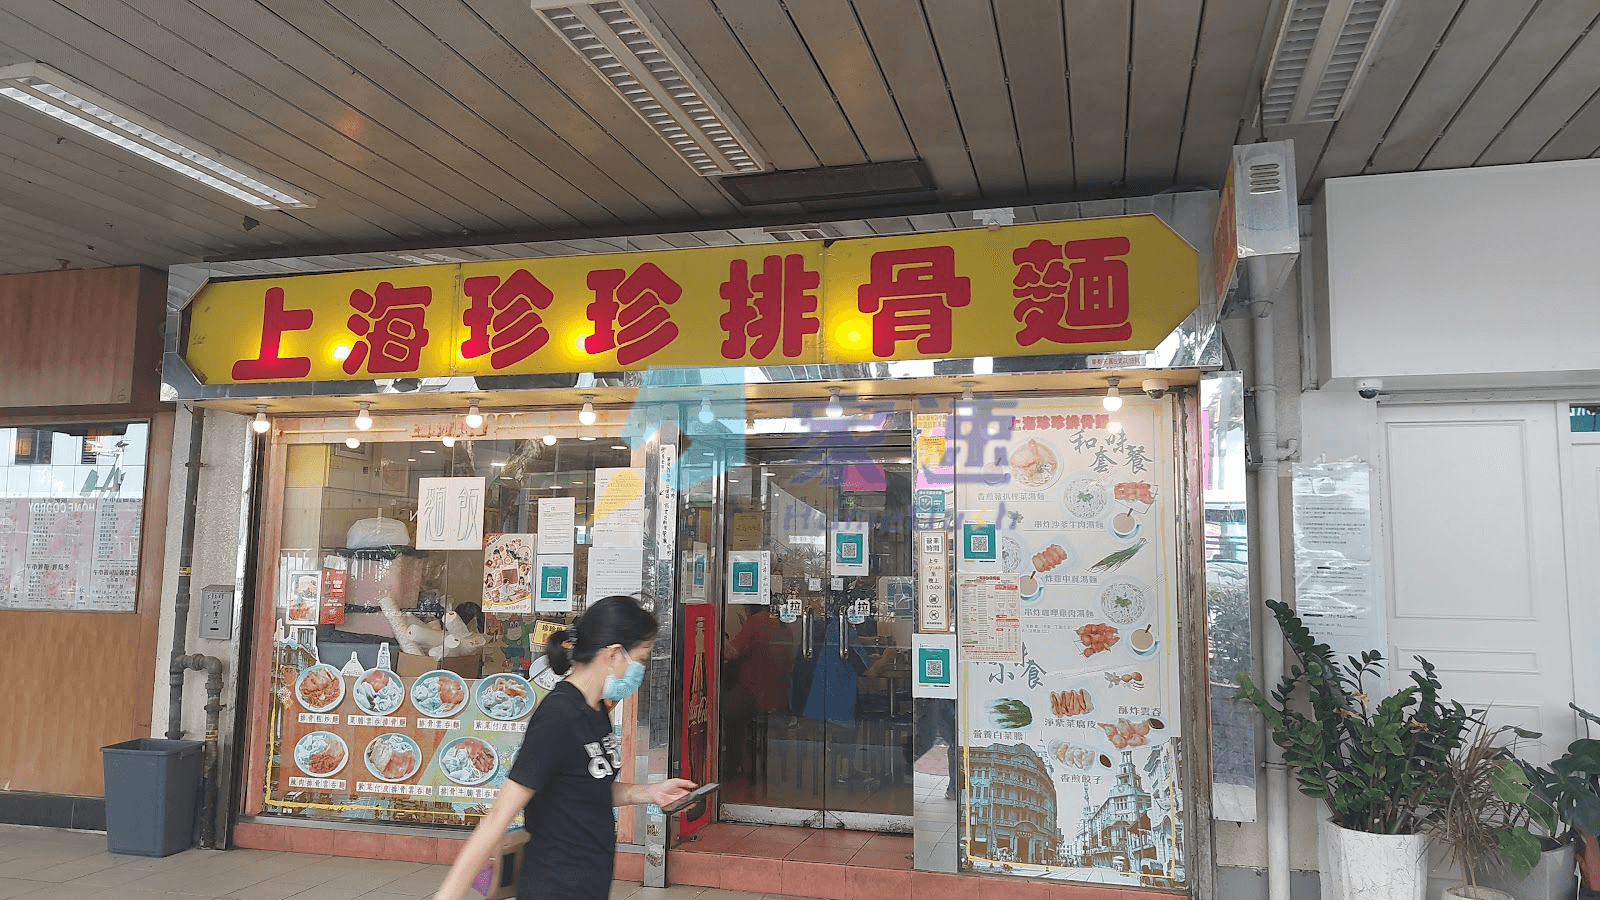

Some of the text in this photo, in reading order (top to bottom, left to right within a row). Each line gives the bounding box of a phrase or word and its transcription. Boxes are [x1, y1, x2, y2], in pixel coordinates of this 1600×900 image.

[231, 236, 1133, 381] 上海珍珍排骨麵
[790, 600, 801, 610] 拉
[857, 601, 869, 611] 拉
[988, 659, 1047, 689] 小食
[1118, 706, 1161, 716] 酥炸雲吞
[419, 720, 460, 729] 排骨雲吞麵
[1044, 718, 1097, 729] 淨紫菜腐皮
[1060, 773, 1102, 785] 香煎餃子
